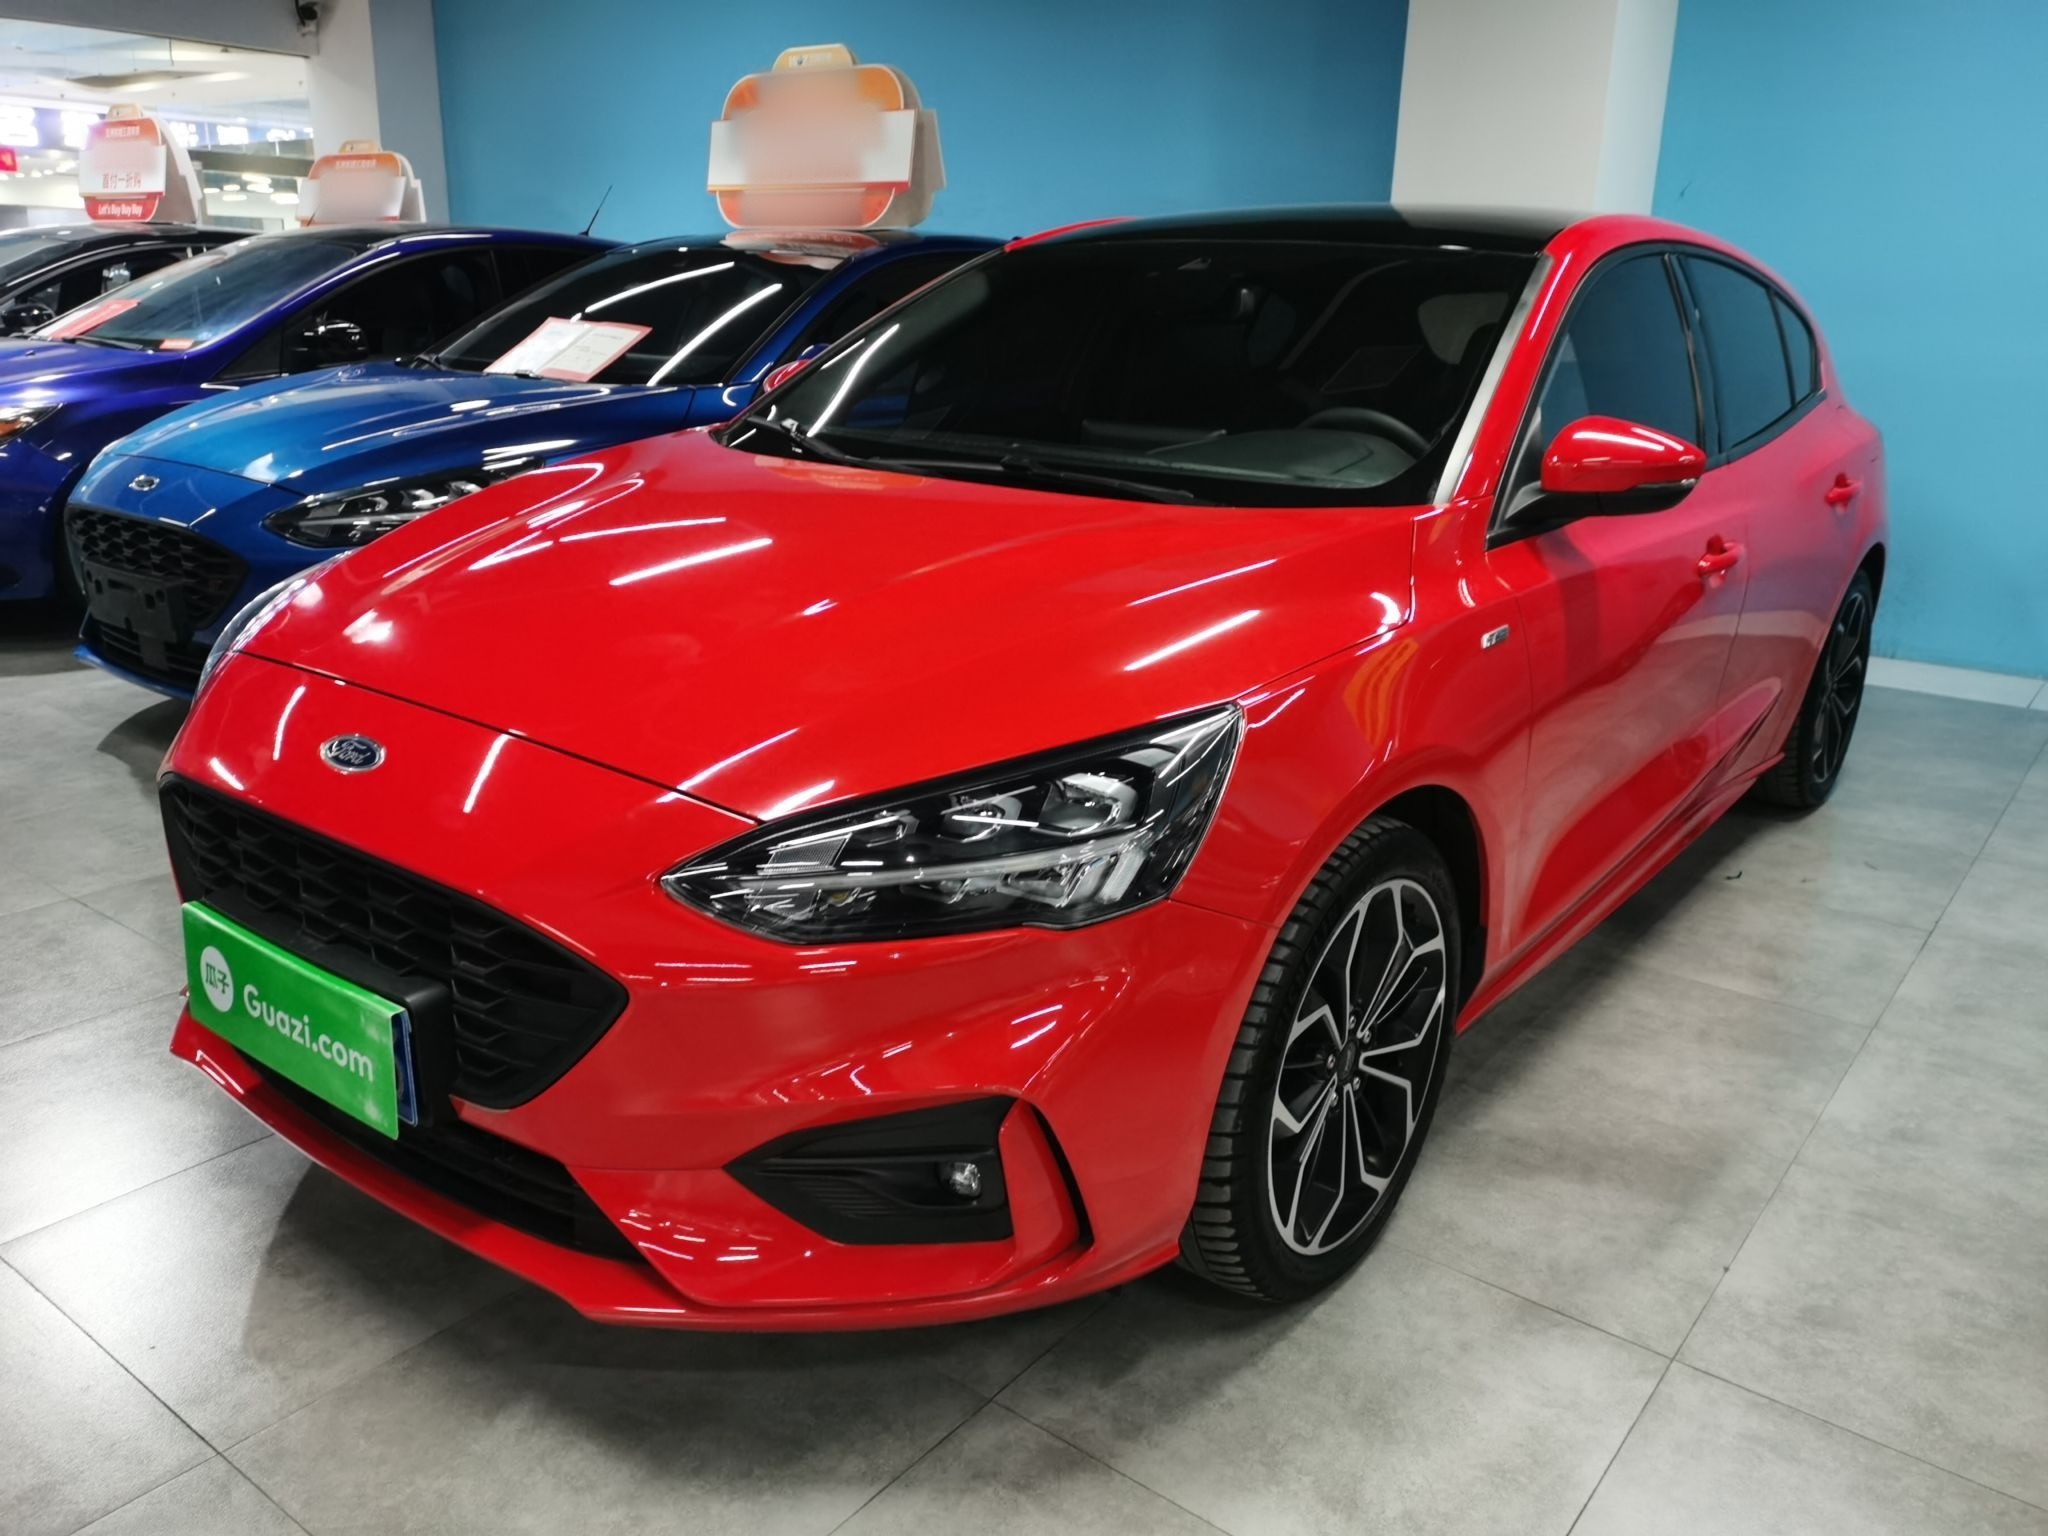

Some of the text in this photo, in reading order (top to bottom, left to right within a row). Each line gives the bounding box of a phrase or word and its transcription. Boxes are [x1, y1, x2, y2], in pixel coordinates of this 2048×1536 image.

[326, 740, 371, 764] Ford
[205, 962, 230, 994] 瓜子
[243, 983, 374, 1082] Guazi.com
